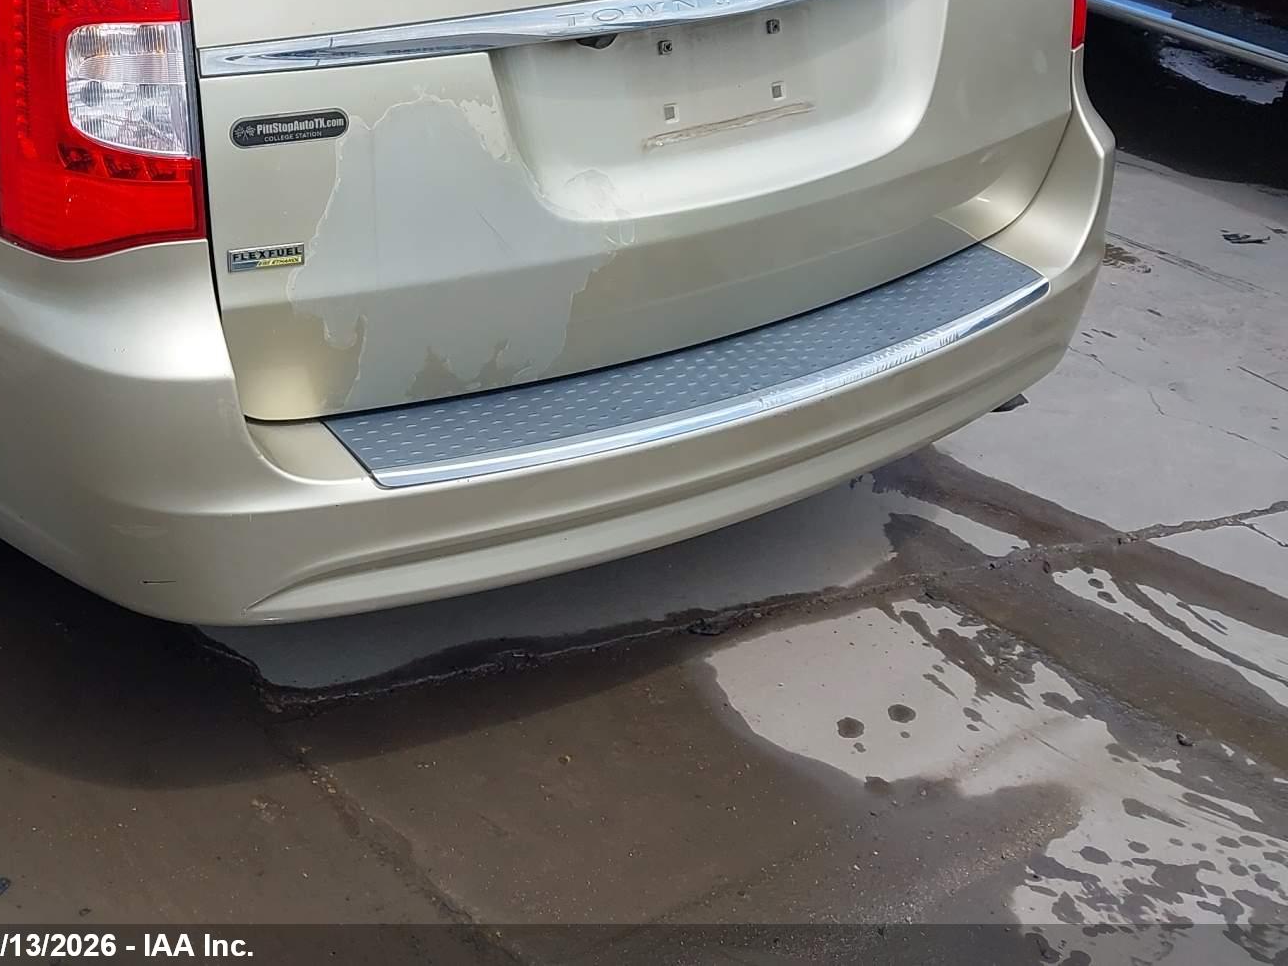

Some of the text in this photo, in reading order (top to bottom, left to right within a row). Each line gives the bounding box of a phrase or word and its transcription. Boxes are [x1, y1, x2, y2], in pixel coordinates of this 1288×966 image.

[264, 131, 322, 142] COLLEGE STATION
[233, 247, 301, 262] FLEXFUEL
